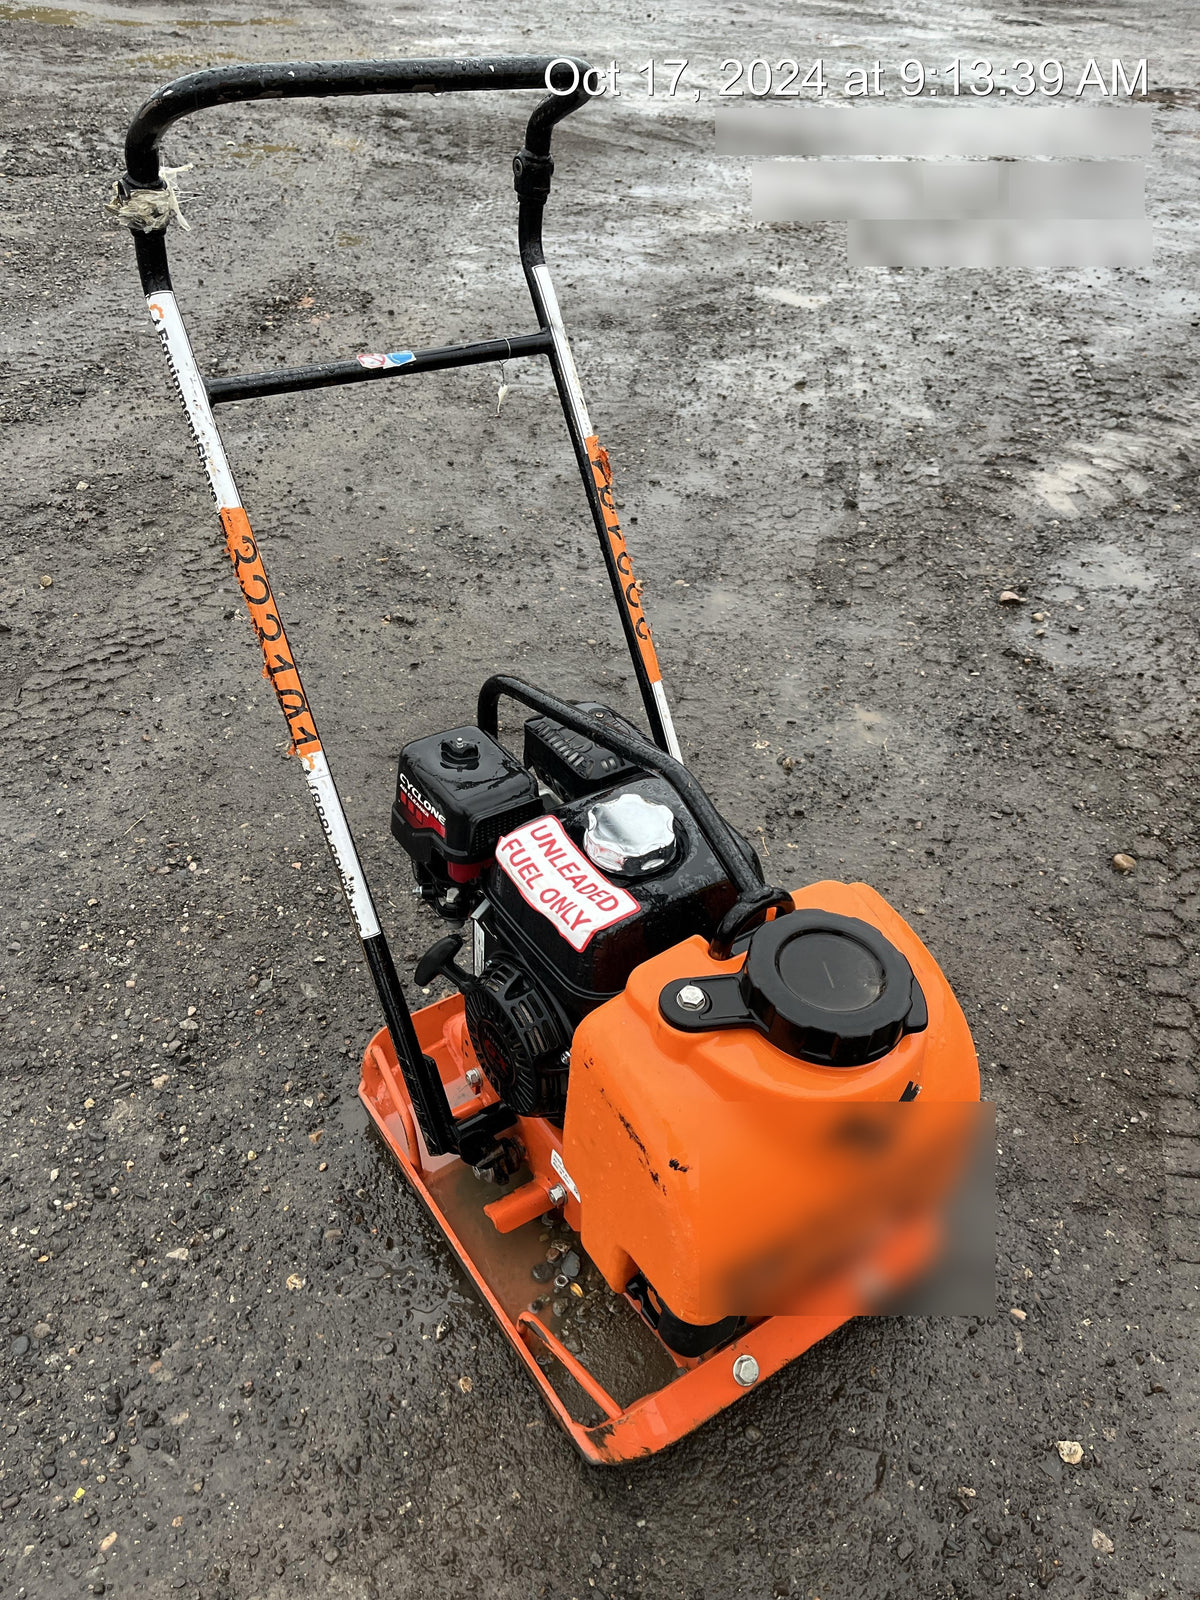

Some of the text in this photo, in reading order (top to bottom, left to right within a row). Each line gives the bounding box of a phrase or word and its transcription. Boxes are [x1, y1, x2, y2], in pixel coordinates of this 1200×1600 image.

[399, 772, 447, 826] CYCLONE
[502, 838, 592, 931] FUEL ONLY
[530, 824, 620, 913] UNLEADED
